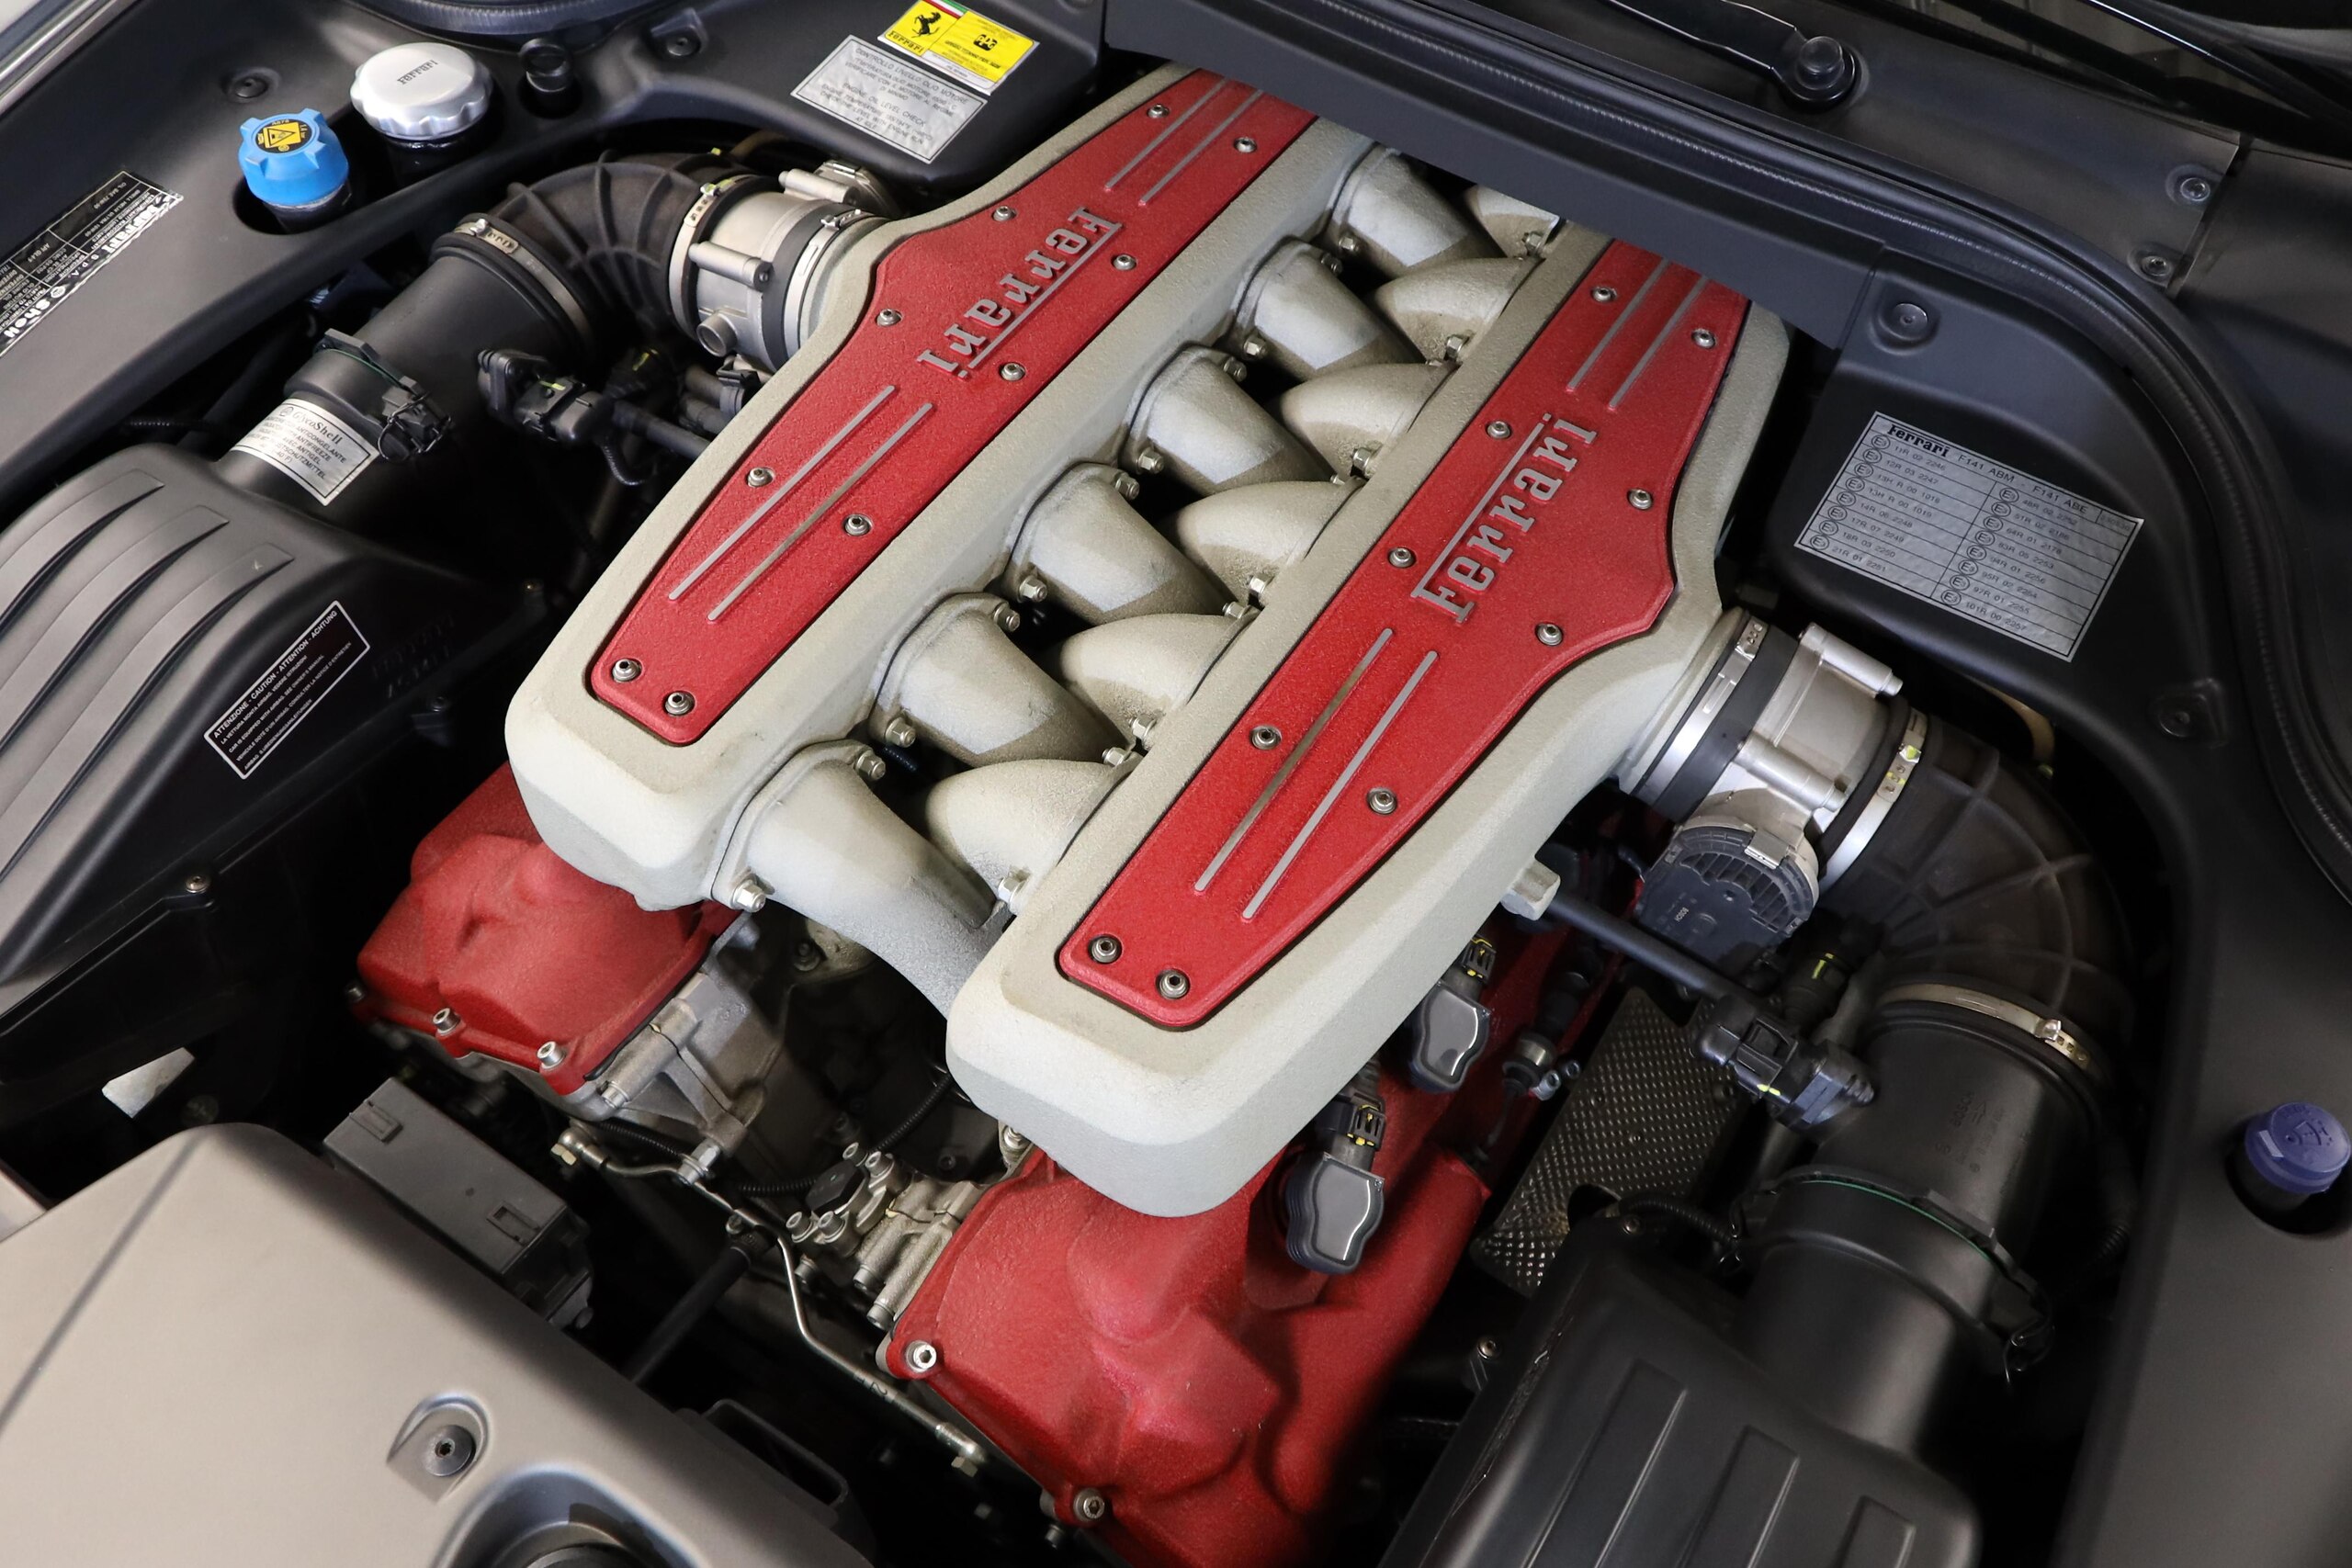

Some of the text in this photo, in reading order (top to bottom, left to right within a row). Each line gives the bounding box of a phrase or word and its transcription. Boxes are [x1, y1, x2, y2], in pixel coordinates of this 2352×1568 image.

[888, 31, 924, 53] Ferrari
[397, 59, 438, 85] Ferrari
[4, 299, 51, 338] Shell
[917, 208, 1123, 379] Ferrari
[292, 411, 342, 445] GlycoShell
[297, 435, 332, 461] ANTIFREEZE
[297, 445, 321, 465] ANTIGEL
[1886, 423, 2088, 513] Ferrari F141 ABM F141 ABE
[1410, 413, 1597, 626] Ferrari
[212, 700, 249, 738] ATTENZIONE
[249, 671, 277, 700] CAUTION
[277, 638, 309, 671] ATTENTION
[310, 609, 337, 638] ACHTUNG
[225, 719, 244, 739] VETTURA
[243, 705, 258, 721] MONTA
[271, 675, 288, 692] VEDERE
[228, 741, 239, 753] CAR
[241, 718, 261, 740] EQUIPPED
[259, 708, 270, 721] WITH
[283, 686, 292, 695] SEE
[307, 653, 324, 671] MANUAL
